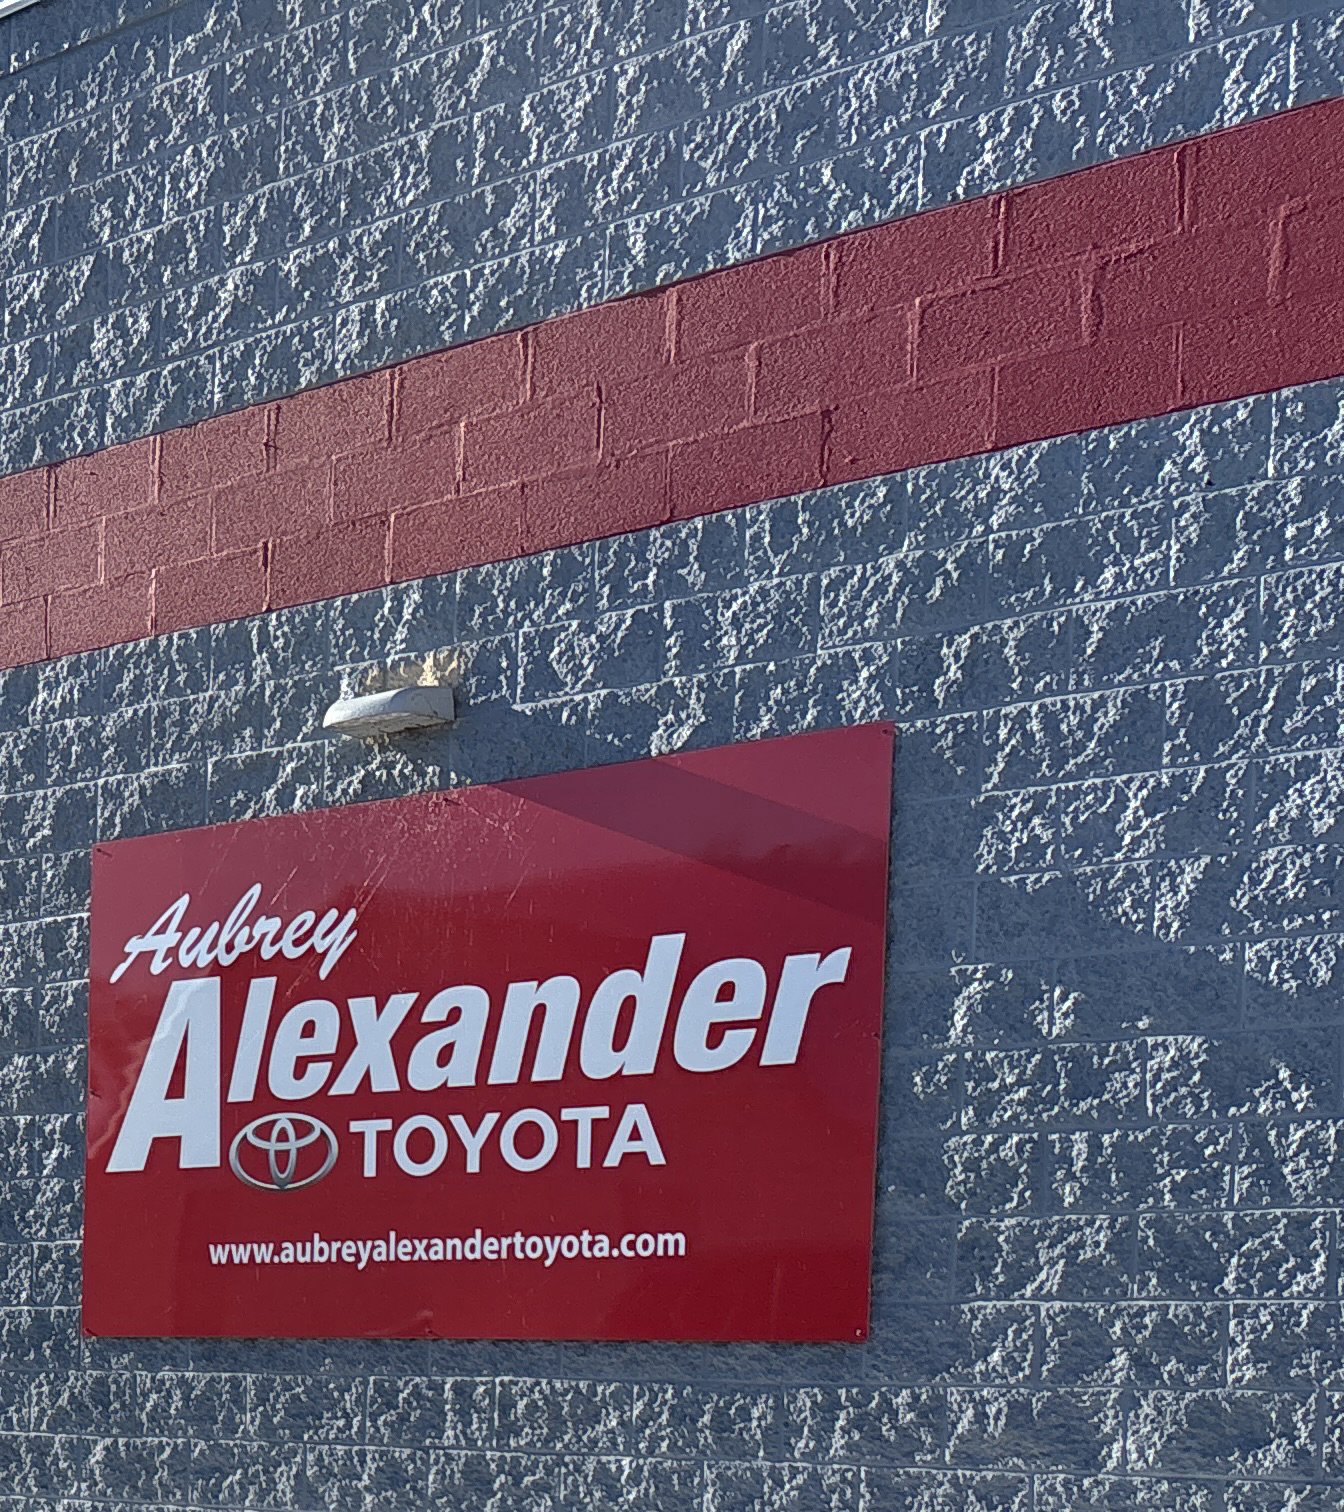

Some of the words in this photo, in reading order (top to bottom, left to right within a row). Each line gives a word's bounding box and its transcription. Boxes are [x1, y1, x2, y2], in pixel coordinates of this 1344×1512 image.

[109, 882, 358, 984] Aubrey
[105, 932, 853, 1174] Alexander
[348, 1103, 667, 1179] TOYOTA
[207, 1228, 687, 1272] www.aubreyalexandertoyota.com
